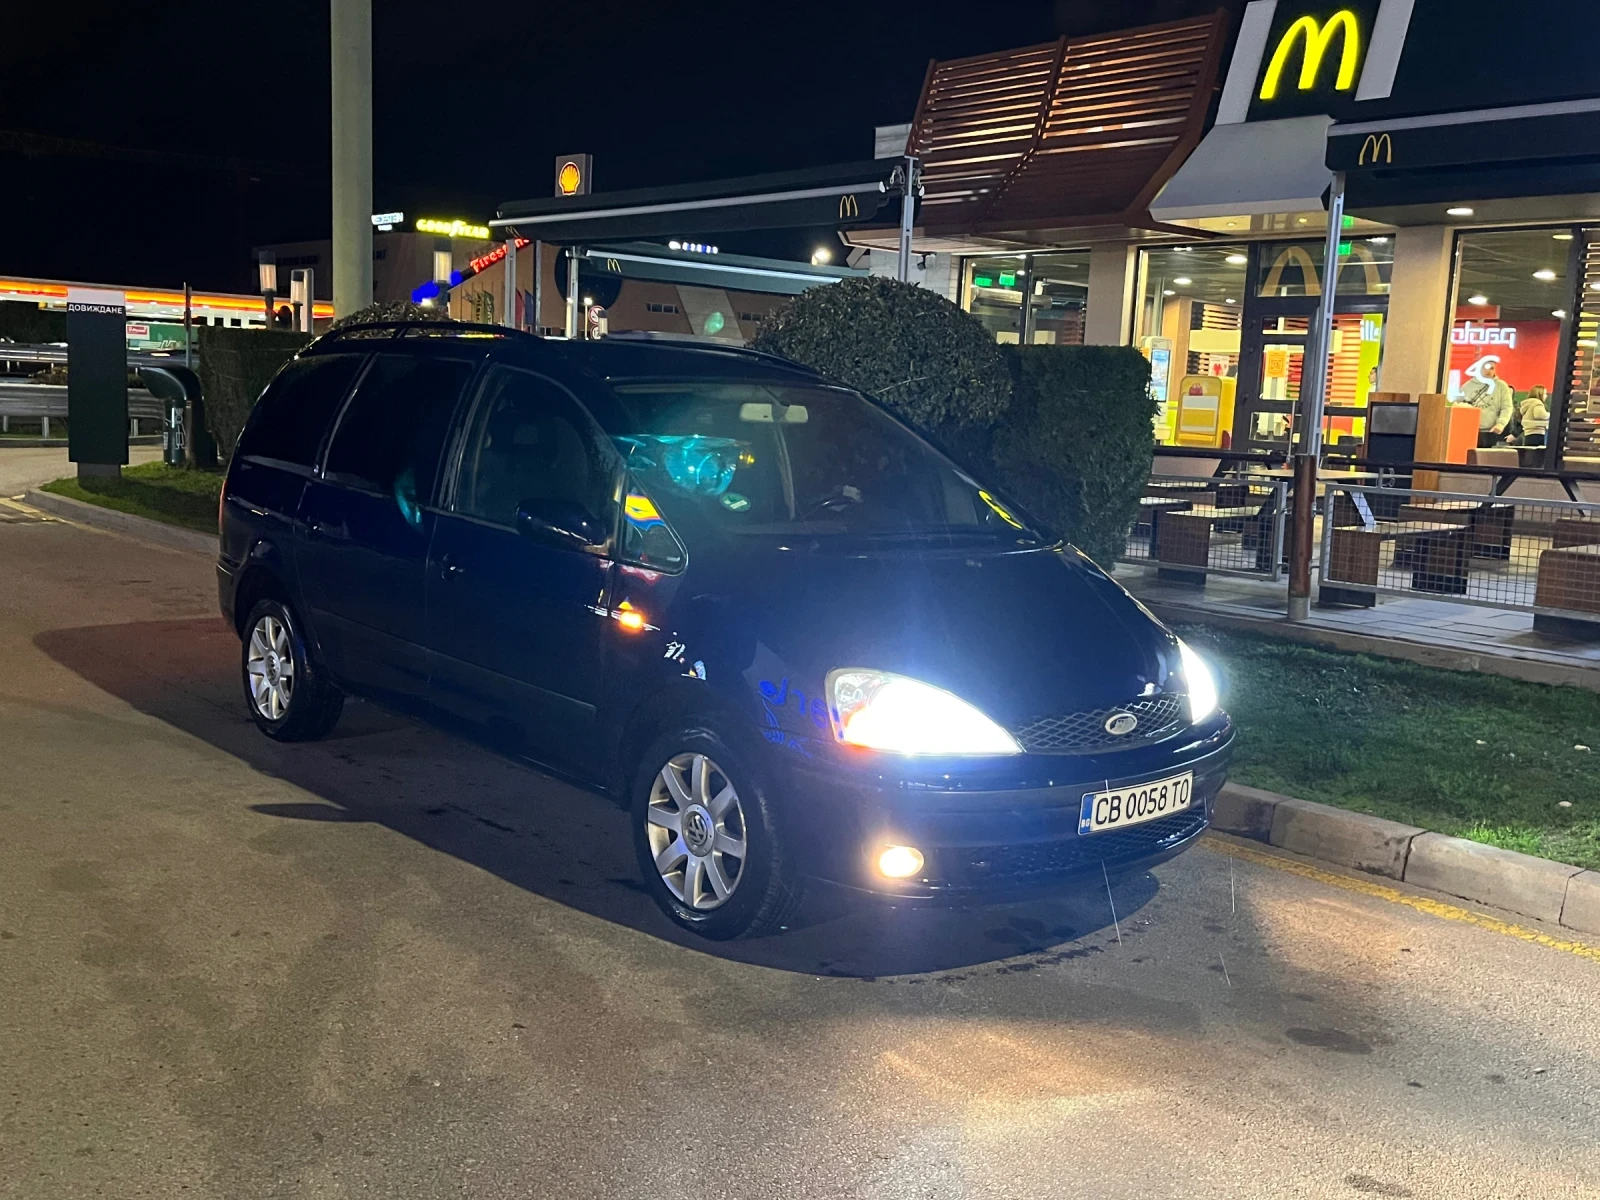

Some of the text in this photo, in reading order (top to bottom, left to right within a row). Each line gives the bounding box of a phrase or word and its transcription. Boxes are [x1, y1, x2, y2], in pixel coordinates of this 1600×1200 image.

[415, 218, 490, 239] GOODYEAR
[68, 303, 123, 314] ДОВИЖДАНЕ
[1095, 778, 1189, 825] CB 0058 TO
